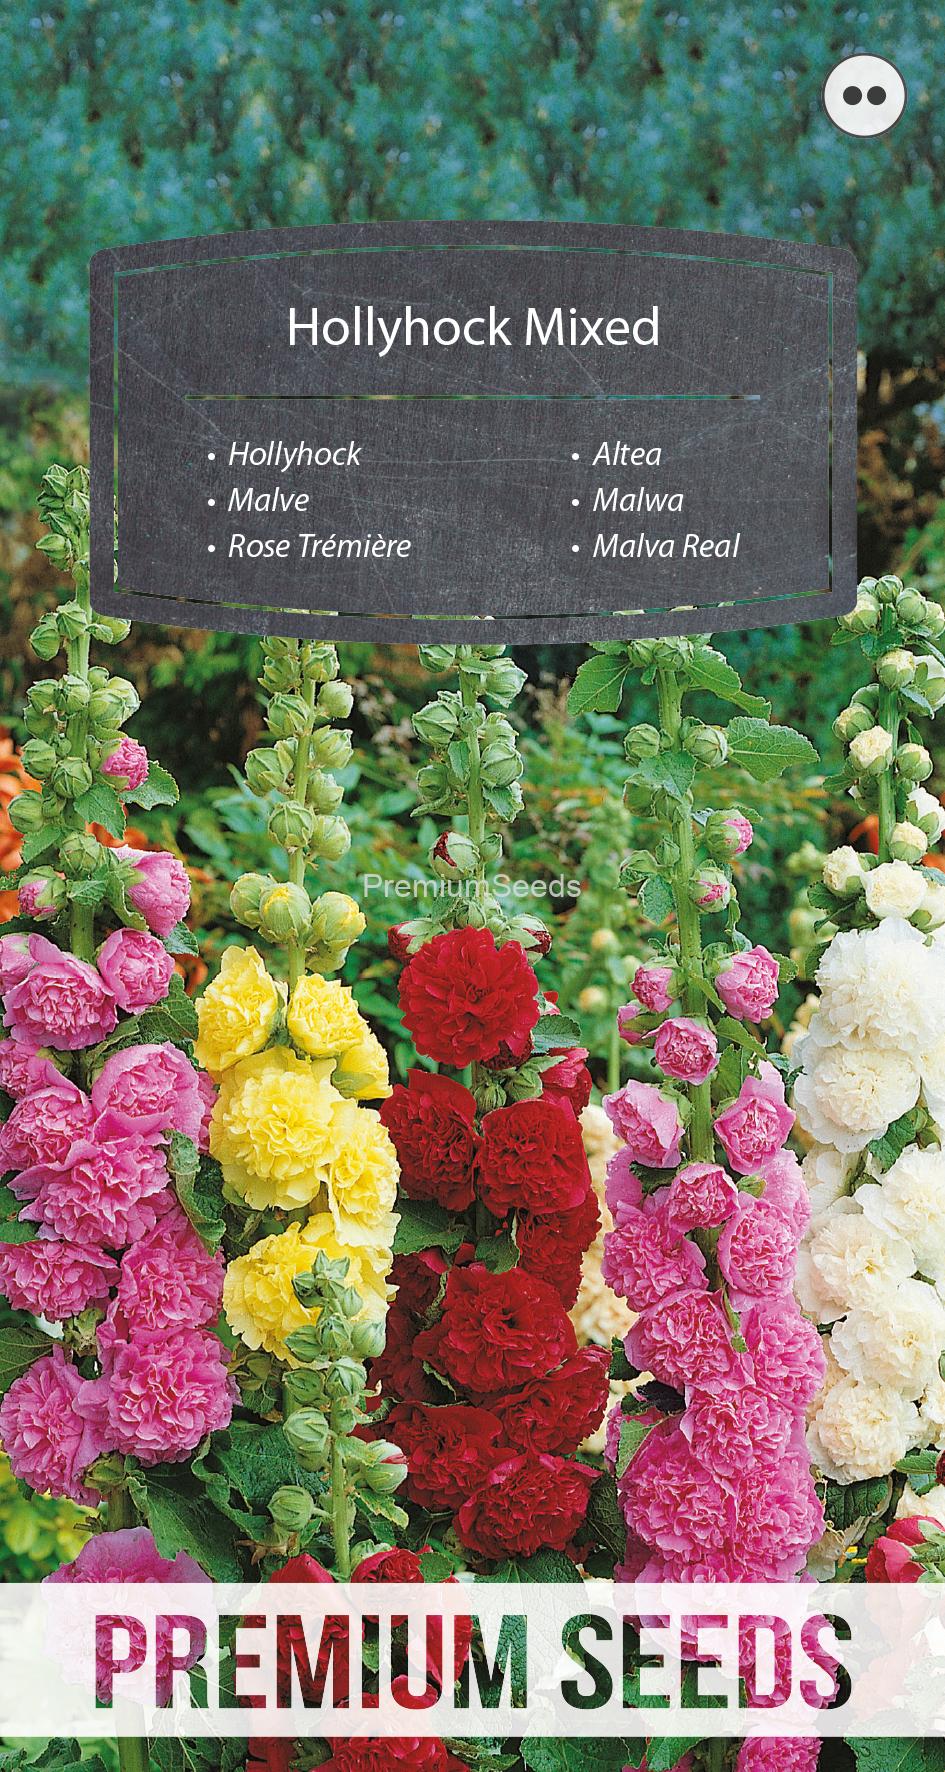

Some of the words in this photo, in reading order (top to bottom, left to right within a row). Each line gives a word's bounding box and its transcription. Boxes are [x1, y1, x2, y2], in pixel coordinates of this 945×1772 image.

[288, 305, 512, 357] Hollyhock
[525, 305, 659, 347] Mixed
[228, 440, 362, 472] Hollyhock
[592, 440, 662, 466] Altea
[228, 486, 310, 512] Malve
[592, 486, 684, 512] Malwa
[228, 533, 290, 558] Rose
[298, 530, 412, 558] Trémière
[592, 532, 676, 558] Malva
[682, 532, 741, 558] Real
[95, 1614, 528, 1709] PREMIUM
[560, 1613, 853, 1710] SEEDS
